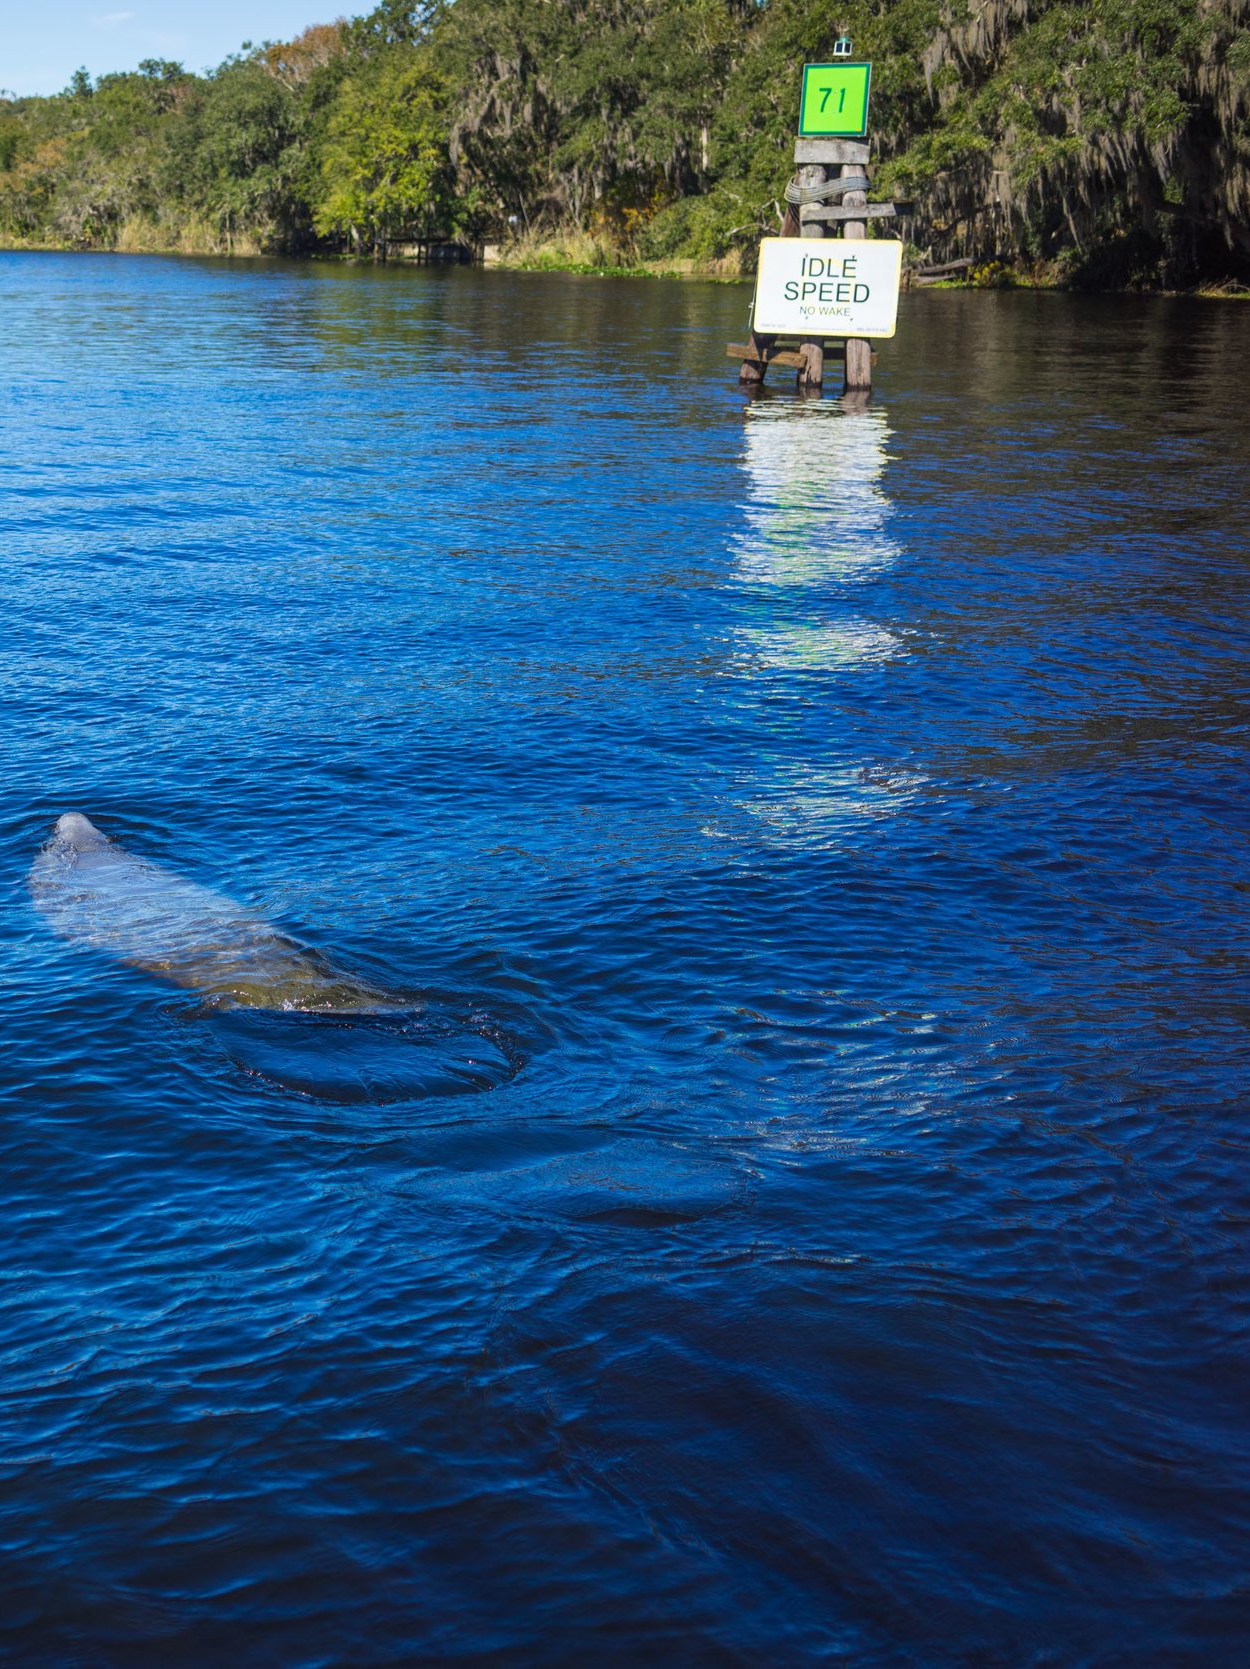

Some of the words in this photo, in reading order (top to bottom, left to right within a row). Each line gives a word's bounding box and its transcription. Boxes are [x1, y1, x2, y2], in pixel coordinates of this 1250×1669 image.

[819, 88, 846, 113] 71
[801, 257, 857, 278] IDLE
[784, 281, 870, 303] SPEED
[799, 306, 815, 315] NO
[818, 306, 851, 316] WAKE
